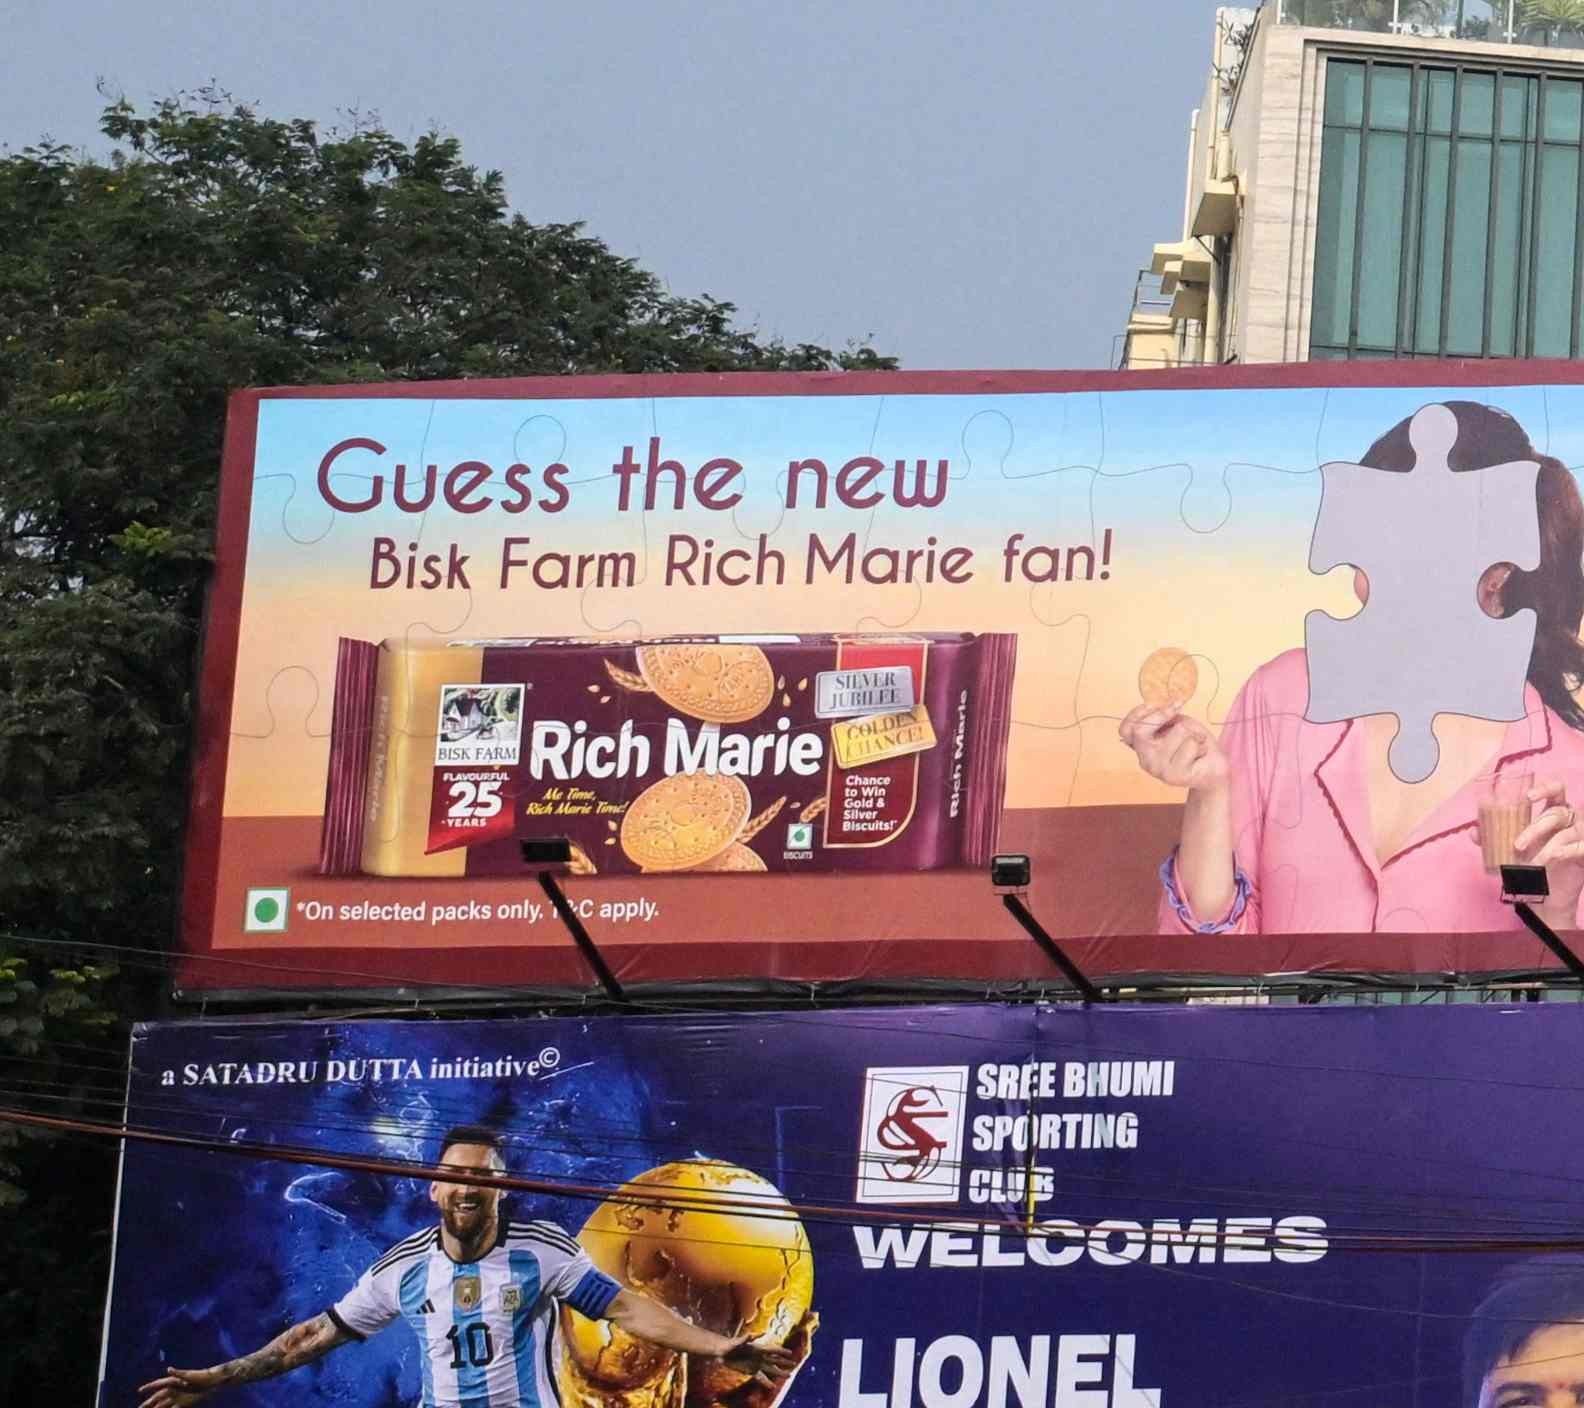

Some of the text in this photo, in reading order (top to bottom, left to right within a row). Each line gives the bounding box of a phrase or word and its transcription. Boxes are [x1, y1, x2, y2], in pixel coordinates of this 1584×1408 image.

[317, 436, 950, 514] Guess the new
[371, 528, 1112, 591] Bisk Farm Rich Marie fan!
[834, 672, 897, 691] SILVER
[831, 689, 901, 710] JUBILEE
[438, 747, 517, 762] BISK FARM
[529, 717, 823, 780] Rich Marie
[845, 787, 886, 798] to Win
[846, 775, 891, 787] Chance
[448, 782, 503, 817] 25
[844, 798, 874, 809] Gold
[447, 818, 487, 827] YEARS
[843, 809, 878, 820] Silver
[340, 899, 427, 921] selected
[431, 899, 488, 925] packs
[492, 898, 543, 924] only.
[600, 898, 659, 922] apply.
[161, 1058, 422, 1086] a SATADRU DUTTA
[976, 1061, 1175, 1100] SREE BHUMI
[972, 1111, 1138, 1152] SPORTING
[968, 1167, 1055, 1204] CLUB
[853, 1216, 1329, 1269] WELCOMES
[448, 1322, 493, 1369] 10
